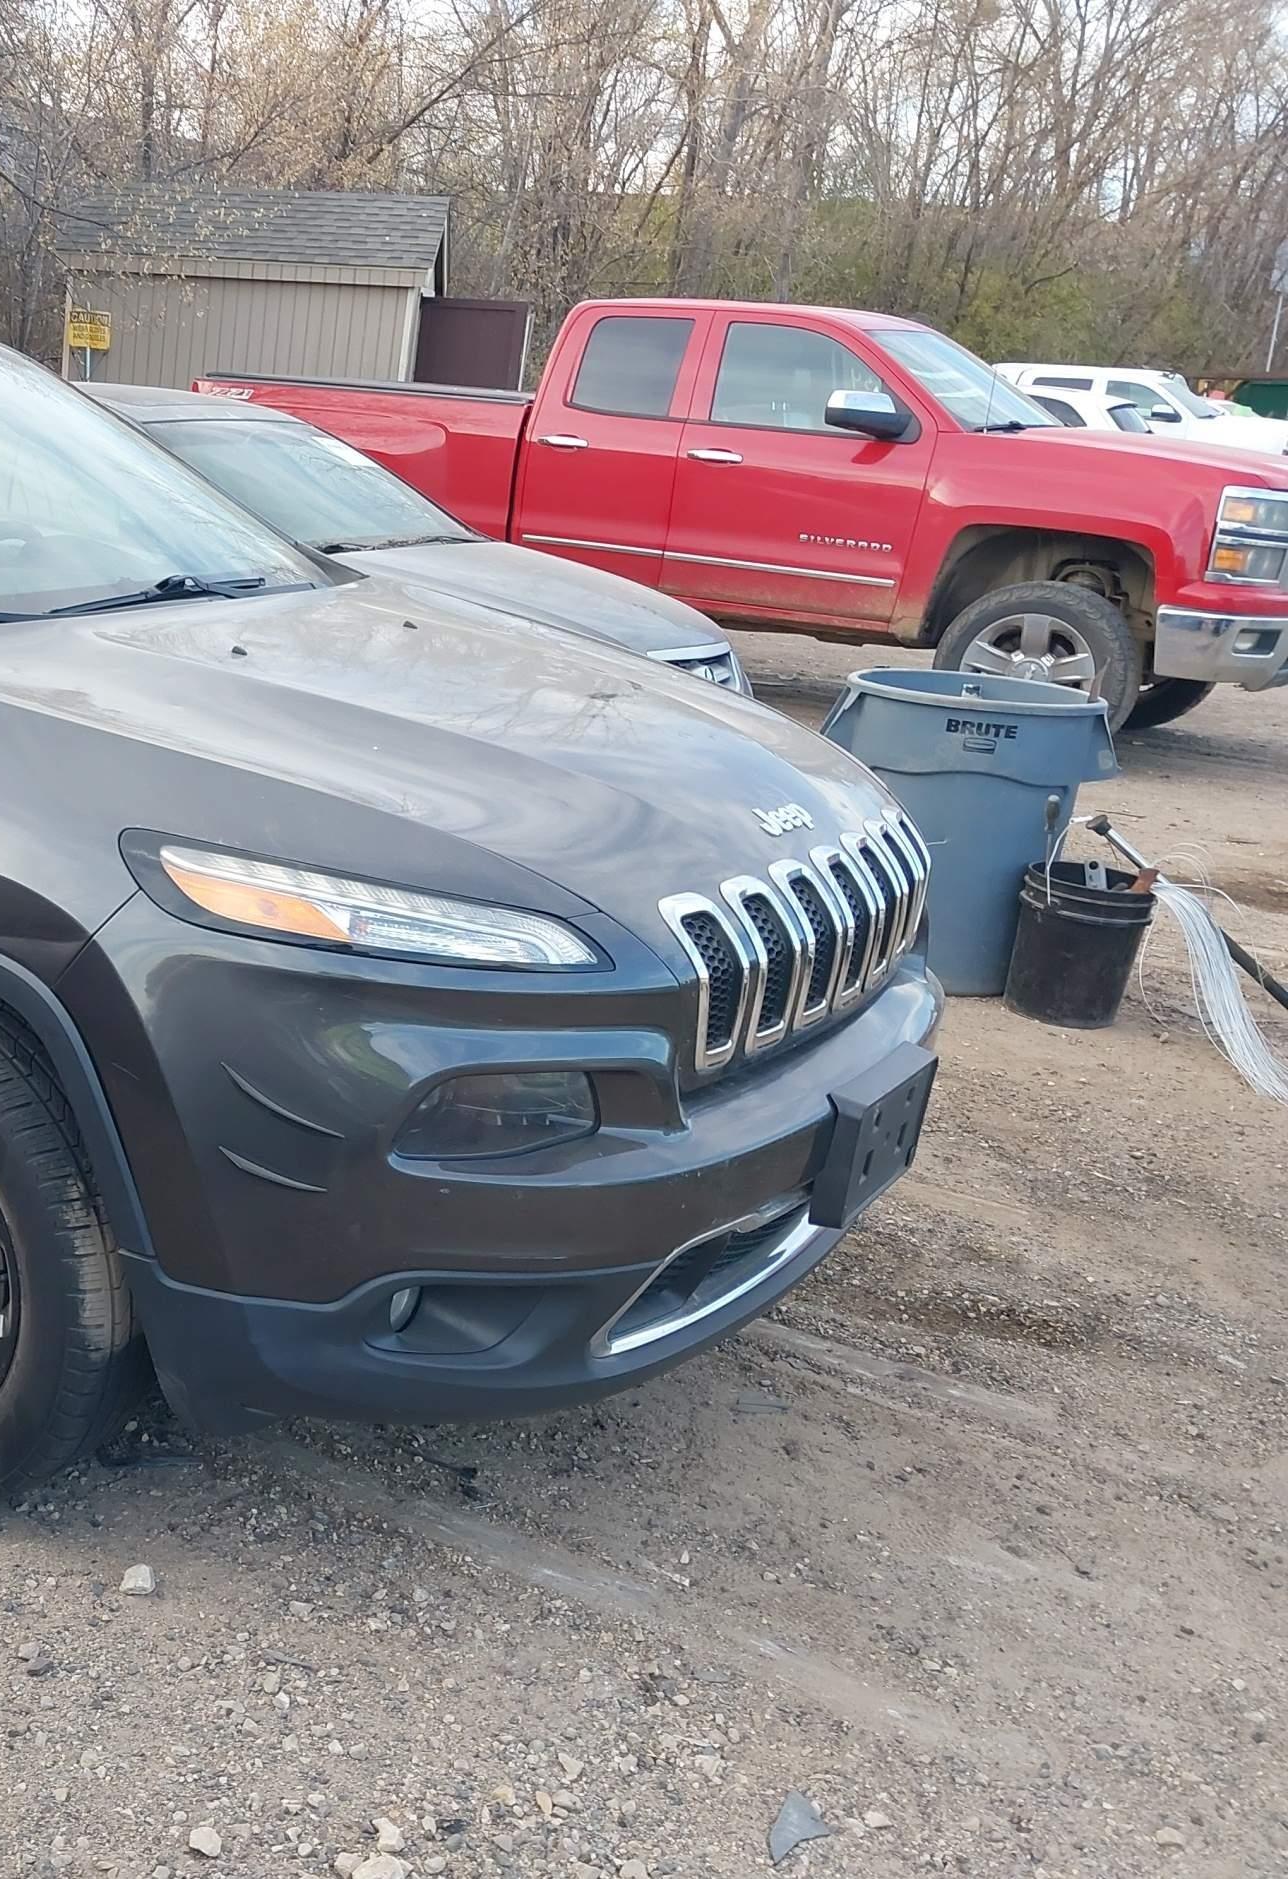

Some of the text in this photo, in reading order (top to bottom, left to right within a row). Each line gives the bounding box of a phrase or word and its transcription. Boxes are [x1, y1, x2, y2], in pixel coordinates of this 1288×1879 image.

[798, 533, 893, 553] SILVERADO
[945, 718, 1018, 739] BRUTE
[751, 803, 815, 837] Jeep
